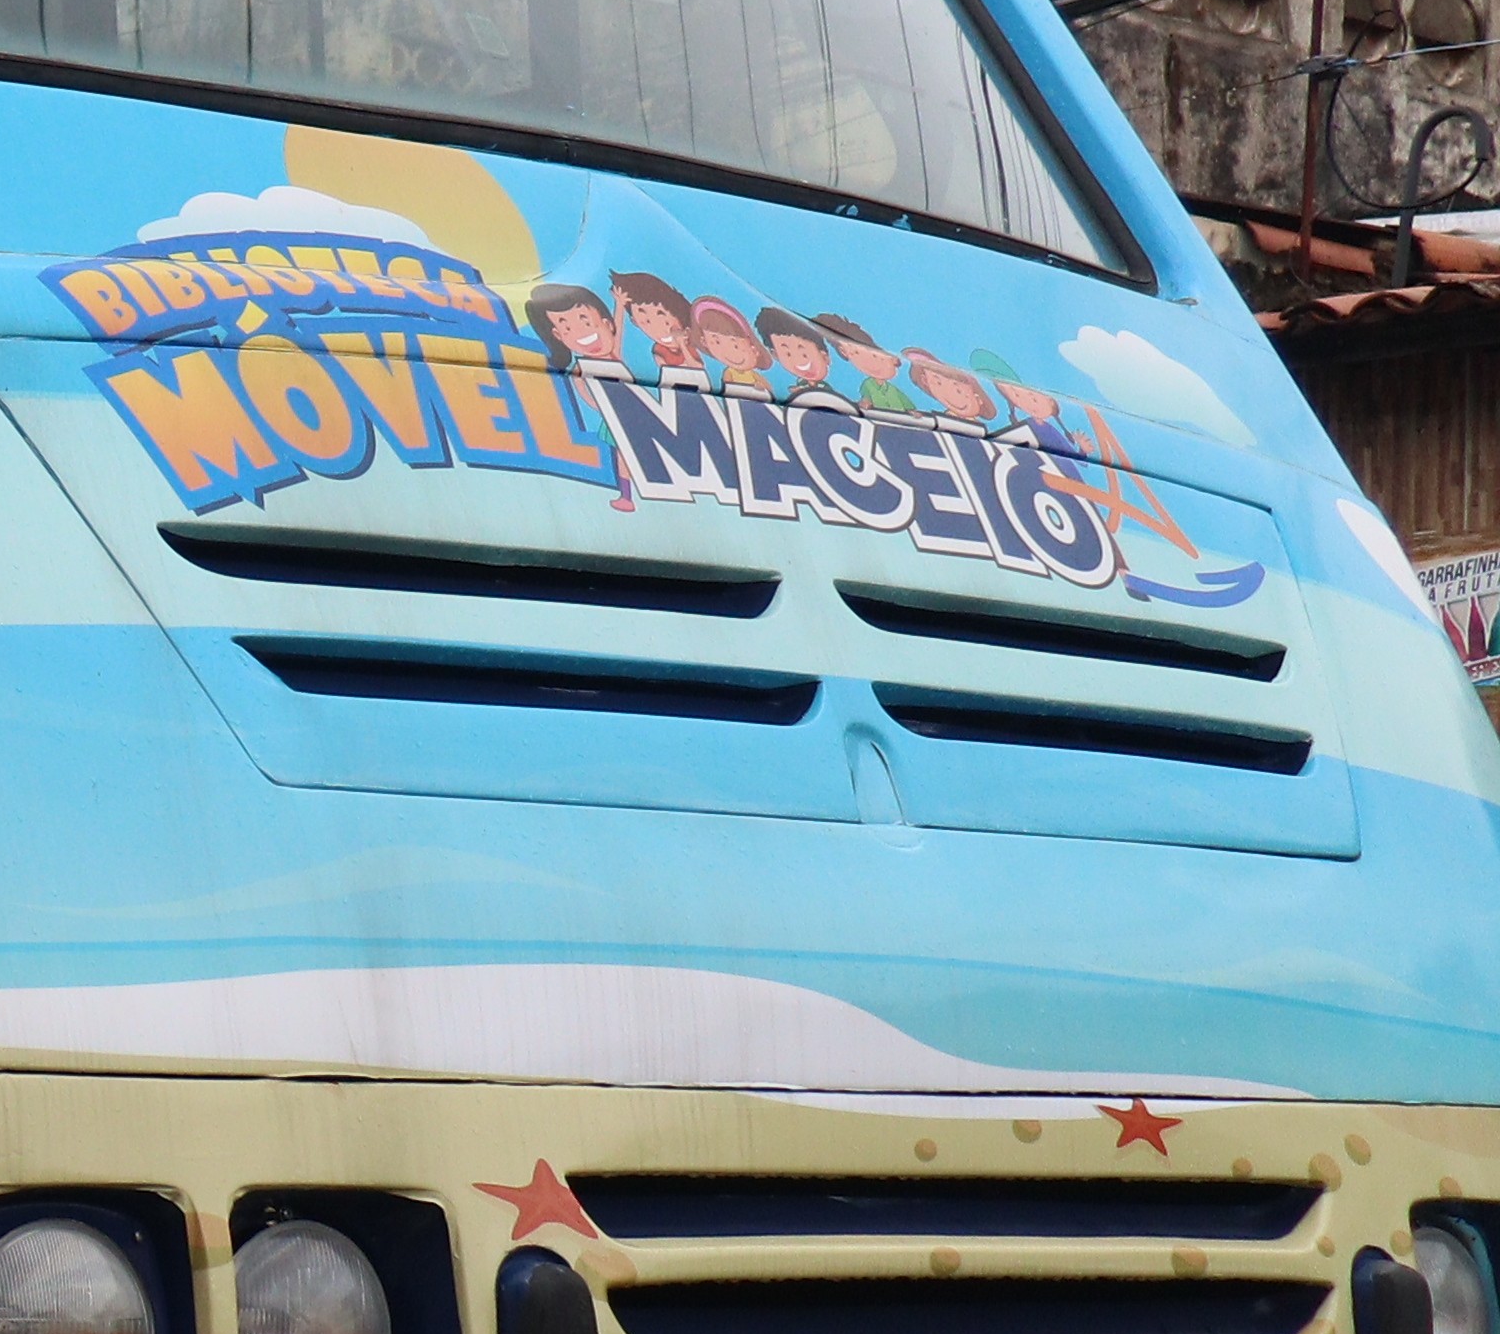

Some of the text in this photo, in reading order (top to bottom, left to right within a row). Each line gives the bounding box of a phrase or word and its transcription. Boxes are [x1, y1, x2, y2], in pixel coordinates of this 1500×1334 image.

[59, 245, 499, 338] BIBLIOTECA
[105, 299, 601, 492] MÓVEL
[577, 357, 1115, 587] MACEIÓ
[1417, 552, 1500, 587] GARRAFINH
[1444, 572, 1500, 599] FRUT
